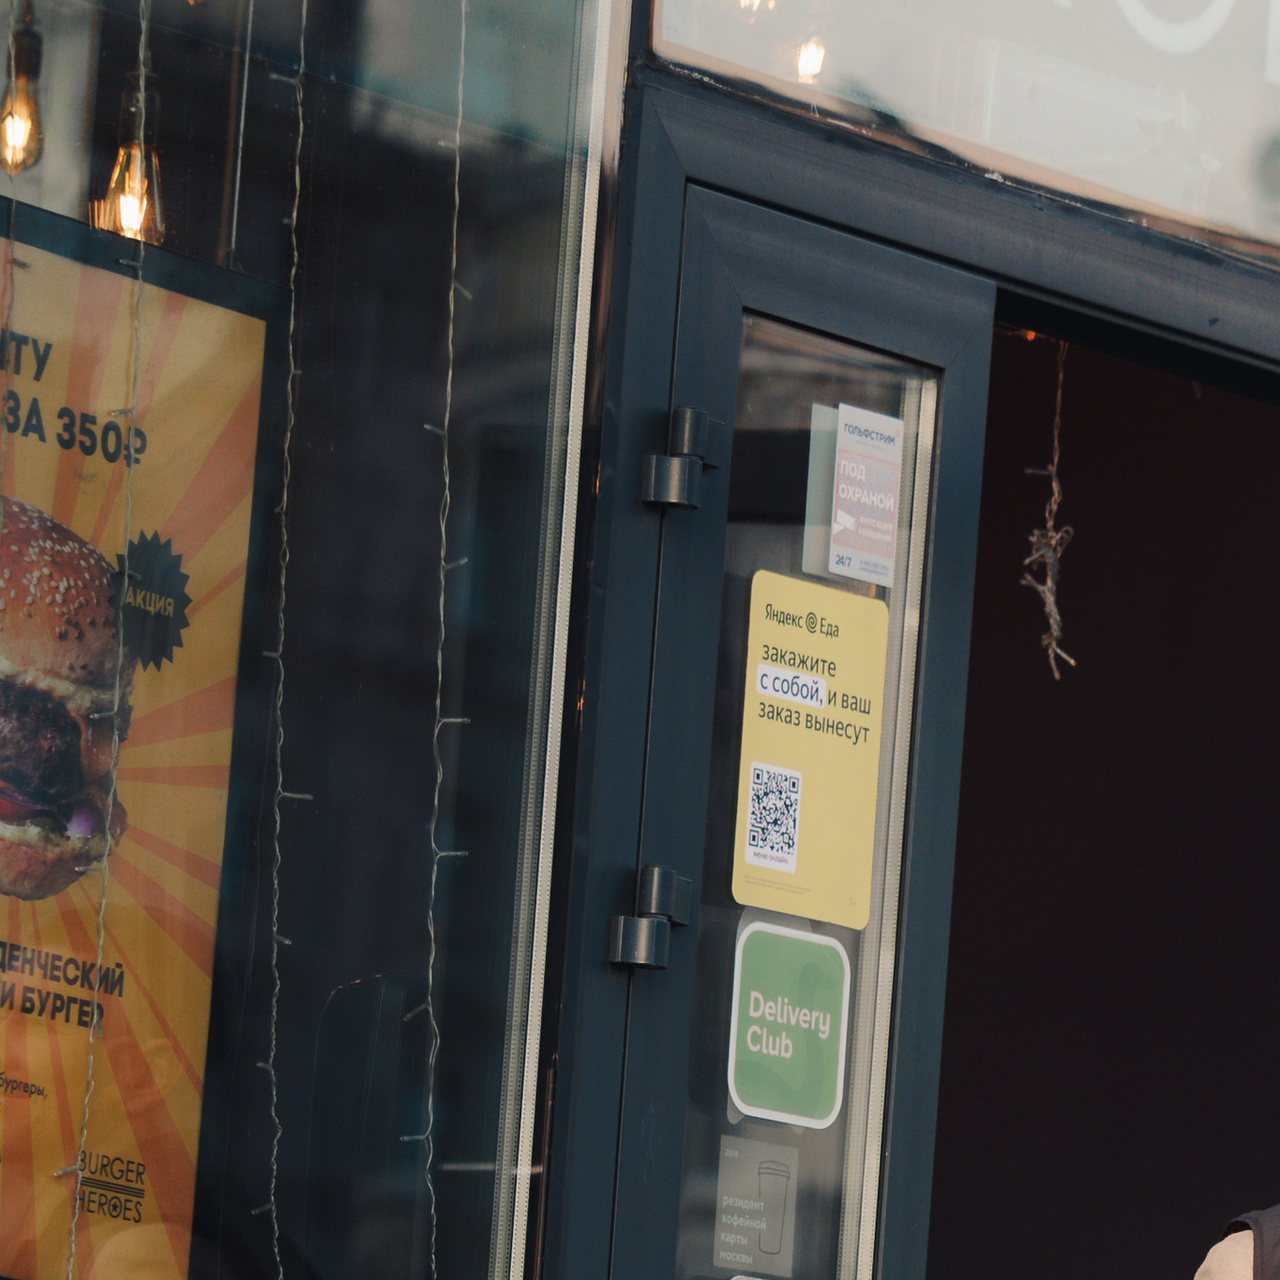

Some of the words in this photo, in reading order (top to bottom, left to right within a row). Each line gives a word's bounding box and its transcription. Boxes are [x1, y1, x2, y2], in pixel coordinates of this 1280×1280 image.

[2, 390, 47, 443] ЗА
[56, 407, 147, 468] 350₽
[844, 423, 896, 446] ГОЛЬФСТРИМ
[839, 460, 867, 482] ПОД
[838, 484, 895, 511] ОХРАНОЙ
[835, 555, 852, 568] 24/7
[124, 587, 175, 618] АКЦИЯ
[765, 603, 803, 627] Яндекс
[820, 617, 840, 639] Еда
[762, 644, 837, 677] закажите
[760, 673, 769, 690] с
[772, 676, 824, 707] собой,
[828, 690, 837, 706] и
[841, 693, 871, 715] ваш
[758, 702, 801, 726] заказ
[805, 713, 870, 745] вынесут
[20, 986, 104, 1031] БУРГЕР
[750, 990, 831, 1039] Delivery
[746, 1025, 793, 1059] Club
[78, 1150, 146, 1185] BURGER
[75, 1190, 143, 1223] HEROES
[720, 1232, 748, 1246] карты
